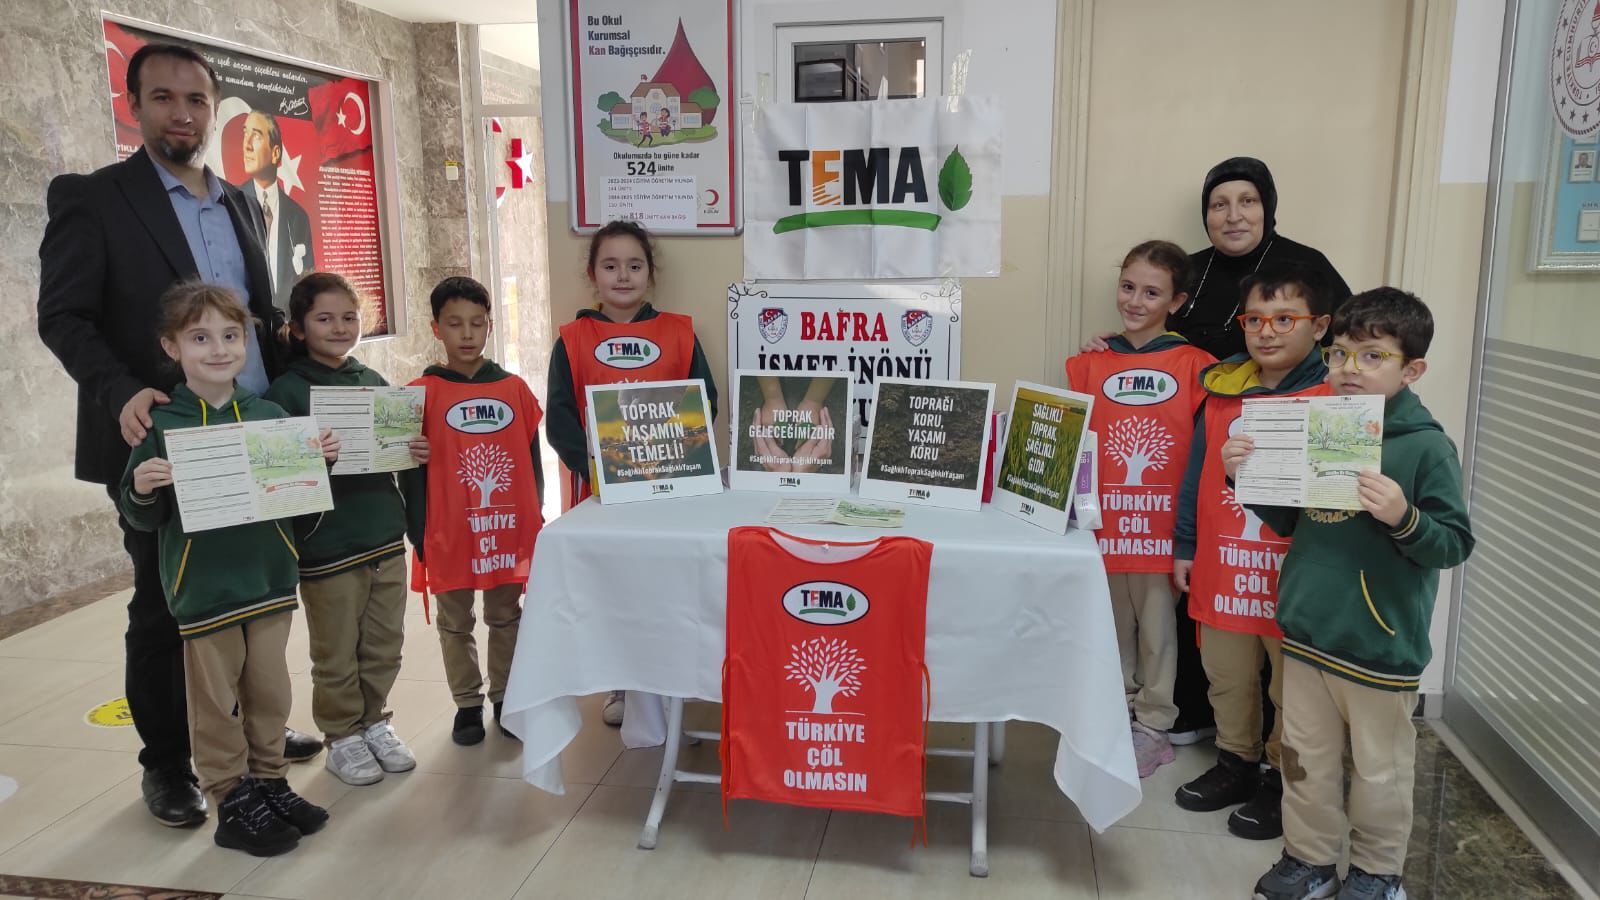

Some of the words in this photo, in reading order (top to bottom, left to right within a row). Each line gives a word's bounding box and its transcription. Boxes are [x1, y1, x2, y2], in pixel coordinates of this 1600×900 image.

[587, 15, 599, 26] Bu
[602, 15, 622, 26] Okul
[588, 30, 630, 41] Kurumsal
[588, 45, 606, 56] Kan
[608, 45, 666, 58] Bağışçısıdır.
[613, 152, 652, 160] Okulumuzda
[663, 152, 680, 160] güne
[627, 161, 656, 176] 524
[778, 146, 929, 206] TEMA
[800, 311, 889, 342] BAFRA
[607, 342, 642, 356] TEMA
[1117, 375, 1155, 391] TEMA
[460, 404, 496, 421] TEMA
[620, 401, 680, 421] TOPRAK,
[909, 395, 953, 412] TOPRAĞI
[1032, 402, 1063, 423] SAĞLIKLI
[772, 409, 812, 423] TOPRAK
[913, 413, 944, 430] KORU,
[621, 421, 685, 447] YAŞAMIN
[749, 423, 835, 441] GELECEĞİMİZDİR
[908, 428, 946, 448] YAŞAMI
[627, 441, 685, 463] TEMELİ!
[910, 445, 939, 461] KORU
[1026, 438, 1056, 459] SAĞLIKLI
[1028, 457, 1045, 475] GIDA
[1103, 489, 1172, 511] TÜRKİYE
[1118, 513, 1151, 537] ÇÖL
[1099, 538, 1173, 556] OLMASIN
[1219, 543, 1285, 571] TÜRKİY
[1234, 570, 1271, 596] ÇÖL
[801, 590, 844, 609] TEMA
[785, 718, 865, 743] TÜRKİYE
[807, 744, 843, 769] ÇÖL
[784, 770, 867, 792] OLMASIN
